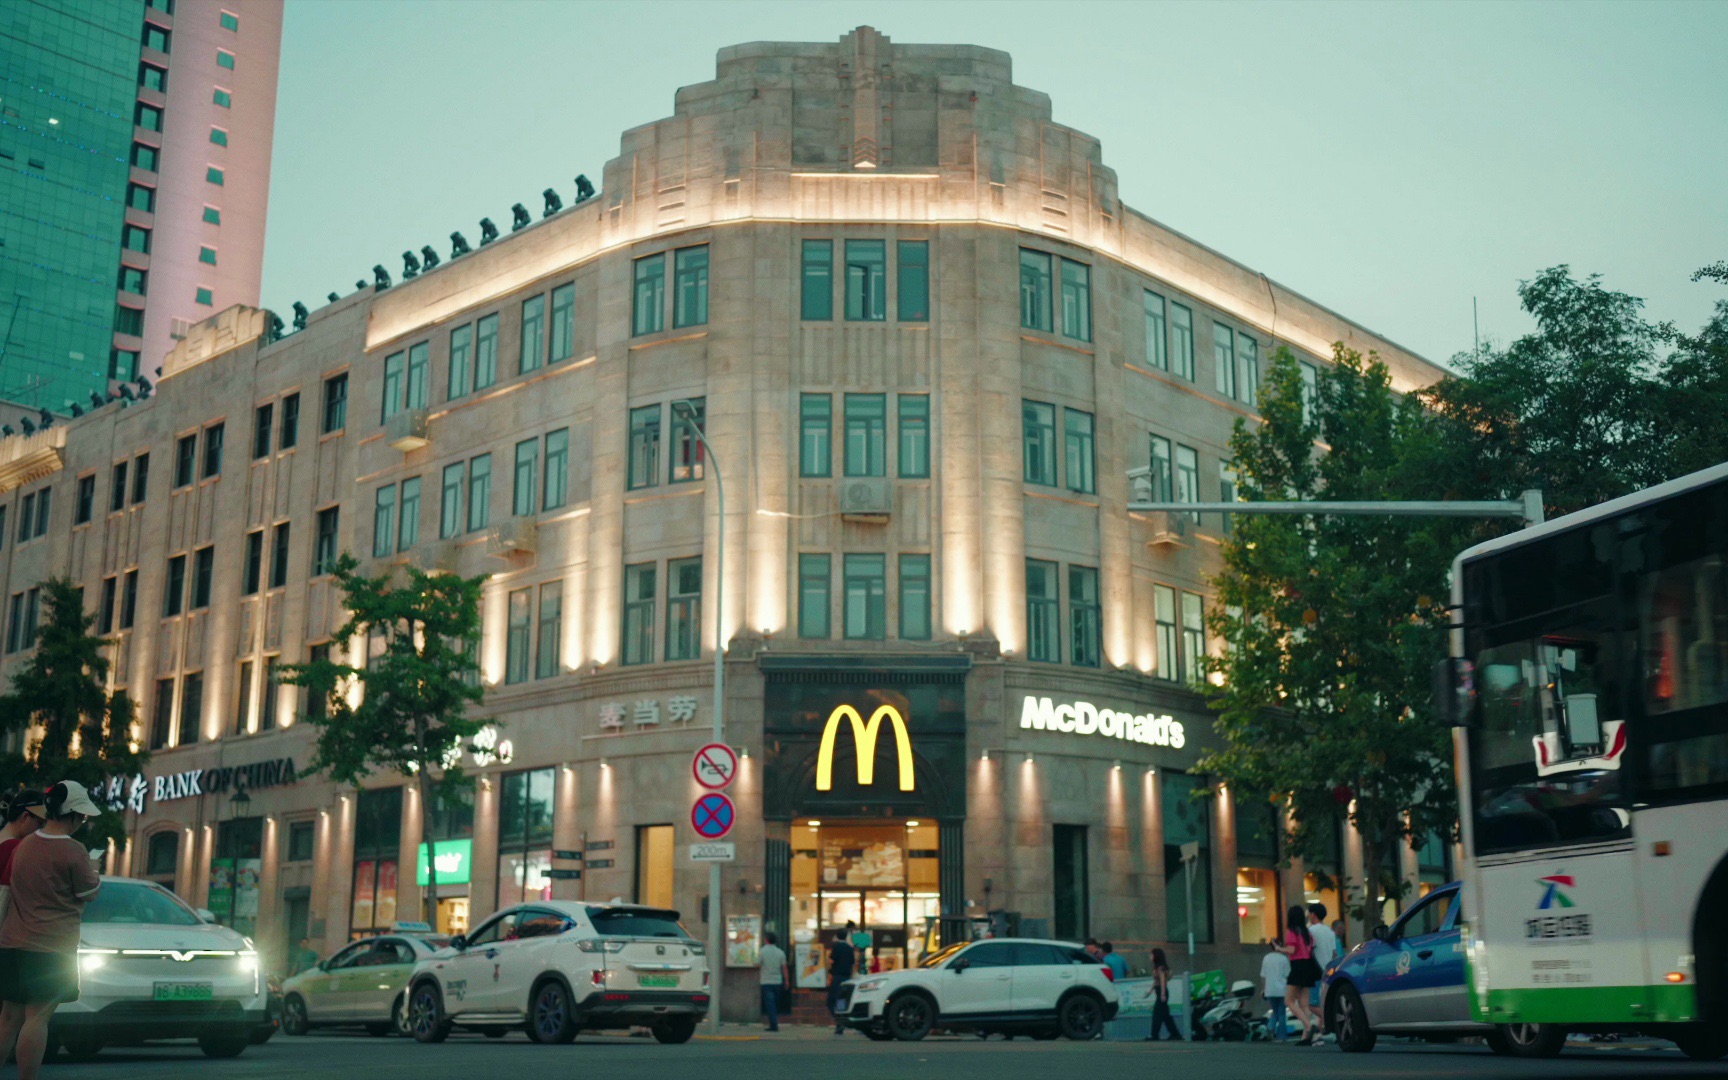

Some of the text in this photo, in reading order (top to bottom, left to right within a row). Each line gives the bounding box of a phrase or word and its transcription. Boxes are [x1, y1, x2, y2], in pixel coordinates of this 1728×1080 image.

[600, 696, 697, 729] 麦当劳
[1020, 695, 1185, 749] McDonald's
[153, 769, 203, 802] BANK
[206, 767, 232, 794] OF
[234, 757, 297, 791] CHINA
[697, 845, 727, 856] 200m
